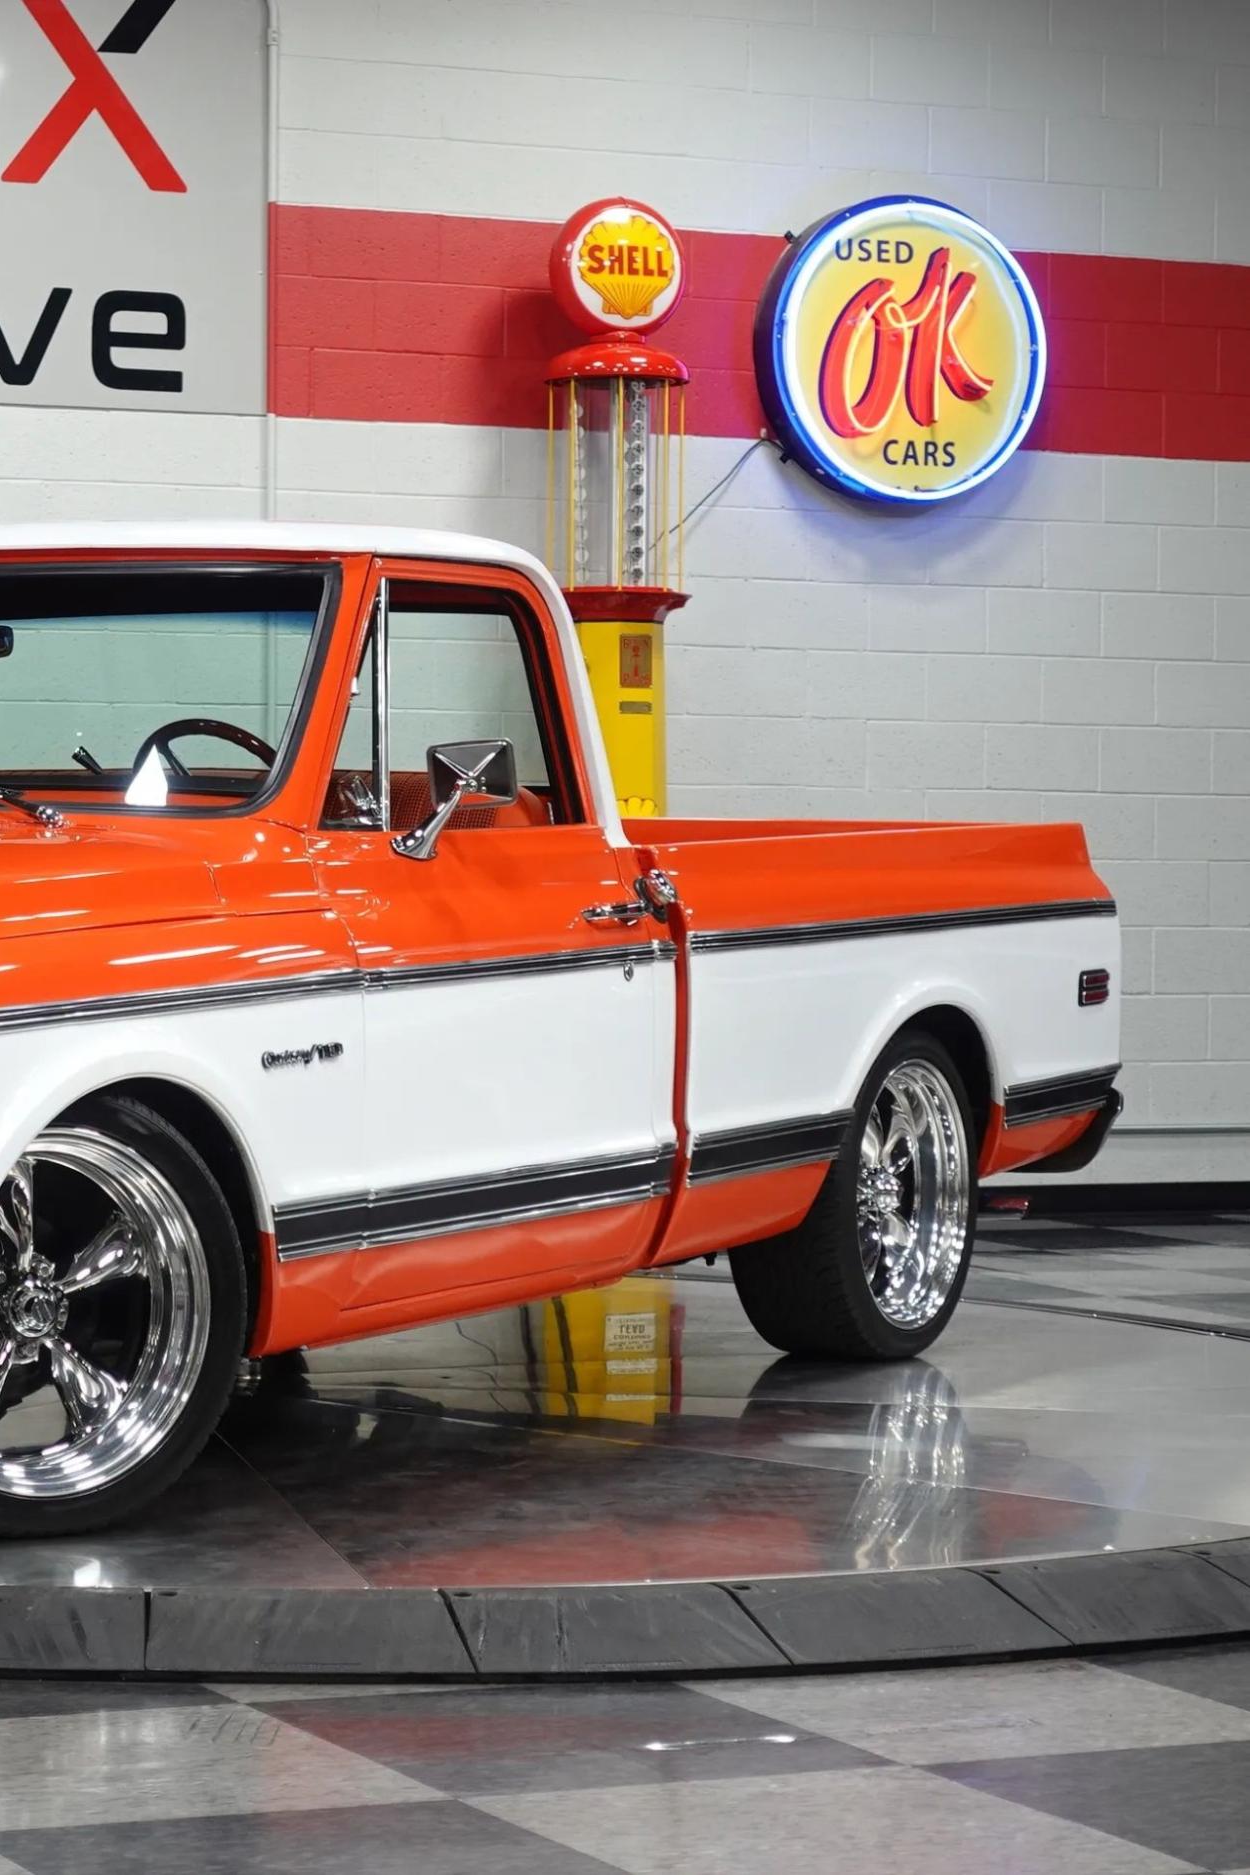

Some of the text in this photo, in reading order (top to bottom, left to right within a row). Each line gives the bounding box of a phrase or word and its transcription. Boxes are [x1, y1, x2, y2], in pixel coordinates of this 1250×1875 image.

[587, 244, 669, 277] SHELL
[834, 238, 914, 264] USED
[818, 246, 994, 439] OK
[882, 439, 956, 467] CARS
